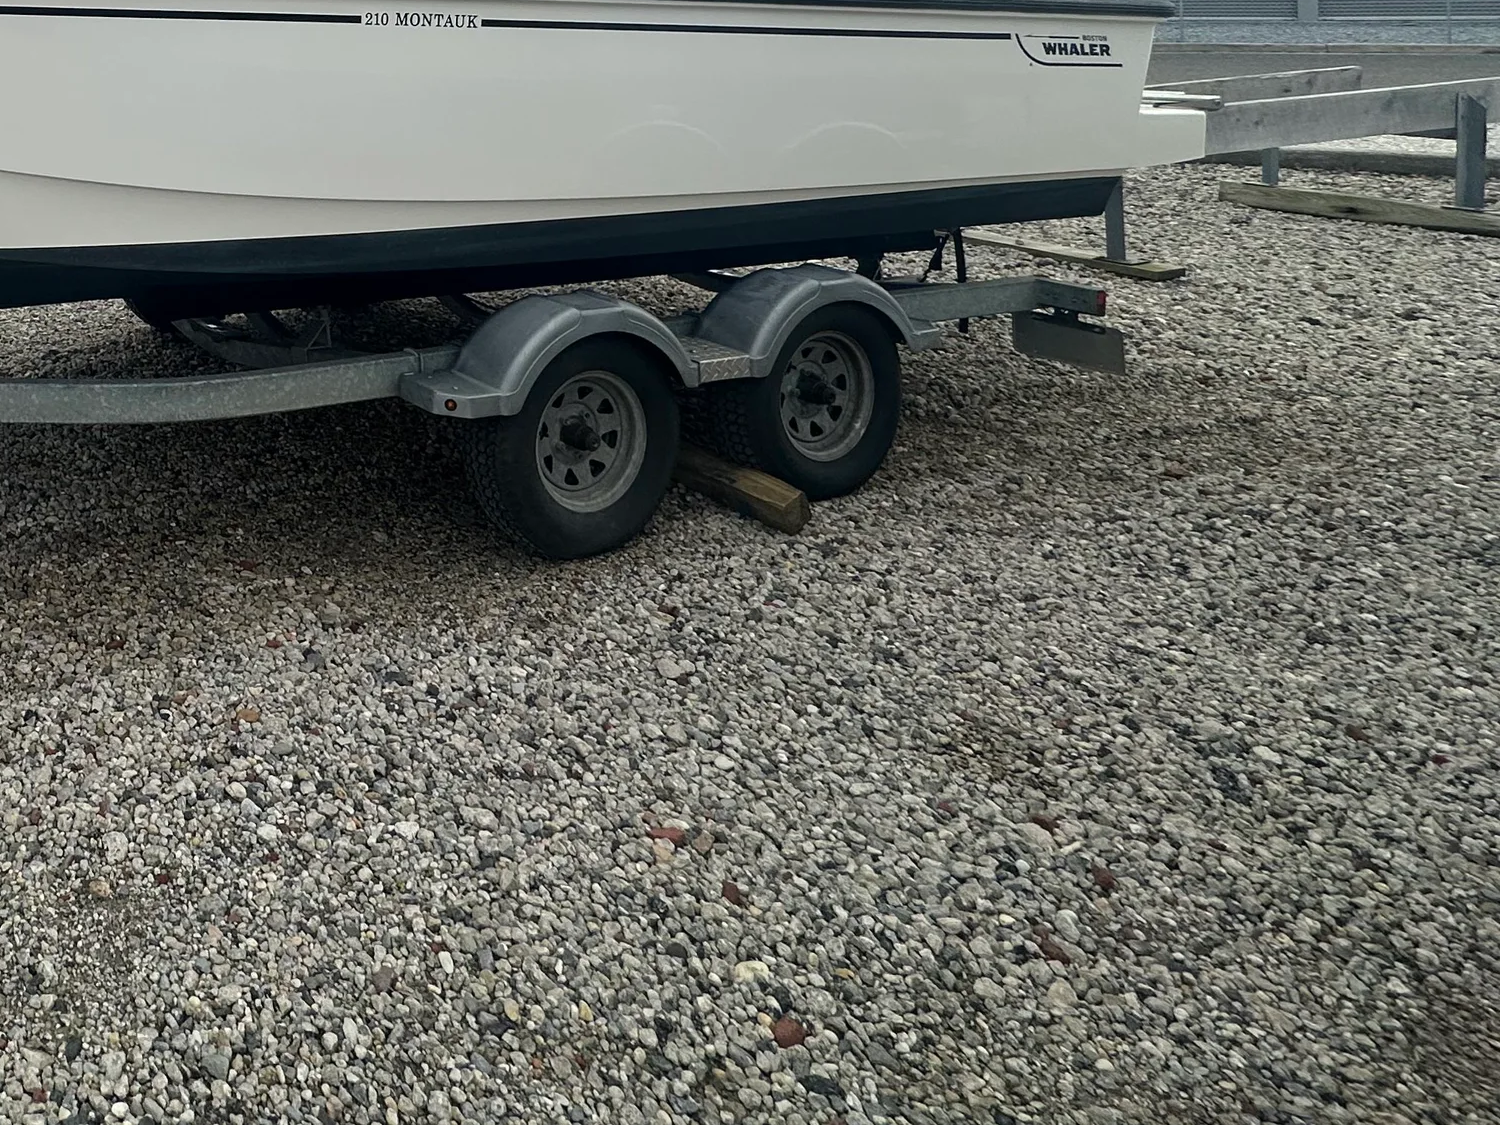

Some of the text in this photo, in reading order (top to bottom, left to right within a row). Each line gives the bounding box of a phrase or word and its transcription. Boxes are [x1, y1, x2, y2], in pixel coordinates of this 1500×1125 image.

[365, 13, 478, 28] 210 MONTAUK
[1042, 42, 1111, 56] WHALER
